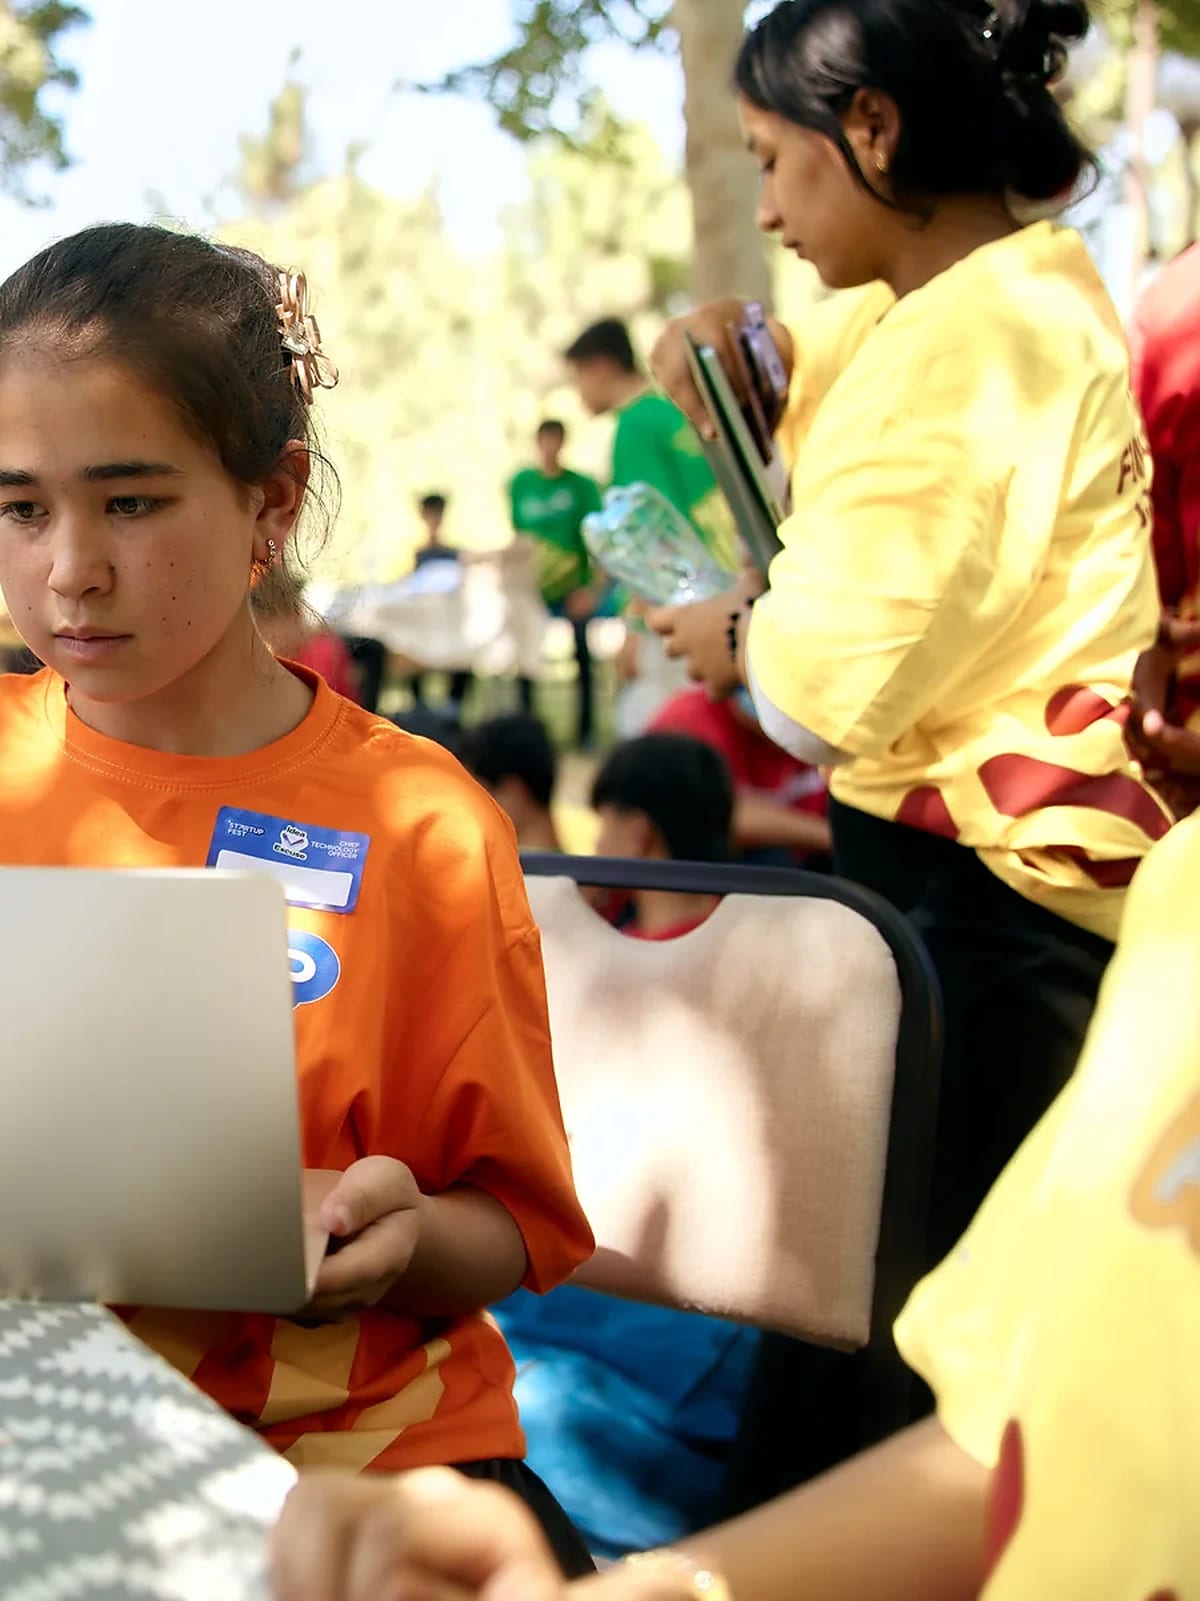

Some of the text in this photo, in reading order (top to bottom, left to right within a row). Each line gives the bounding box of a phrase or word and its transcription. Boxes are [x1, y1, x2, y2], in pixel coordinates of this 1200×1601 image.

[227, 828, 246, 837] FEST
[228, 821, 265, 835] STARTUP
[286, 825, 305, 837] Idea
[310, 841, 360, 854] TECHNOLOGY
[339, 840, 360, 848] CHIEF
[274, 844, 306, 860] Excuse
[327, 849, 358, 859] OFFICER
